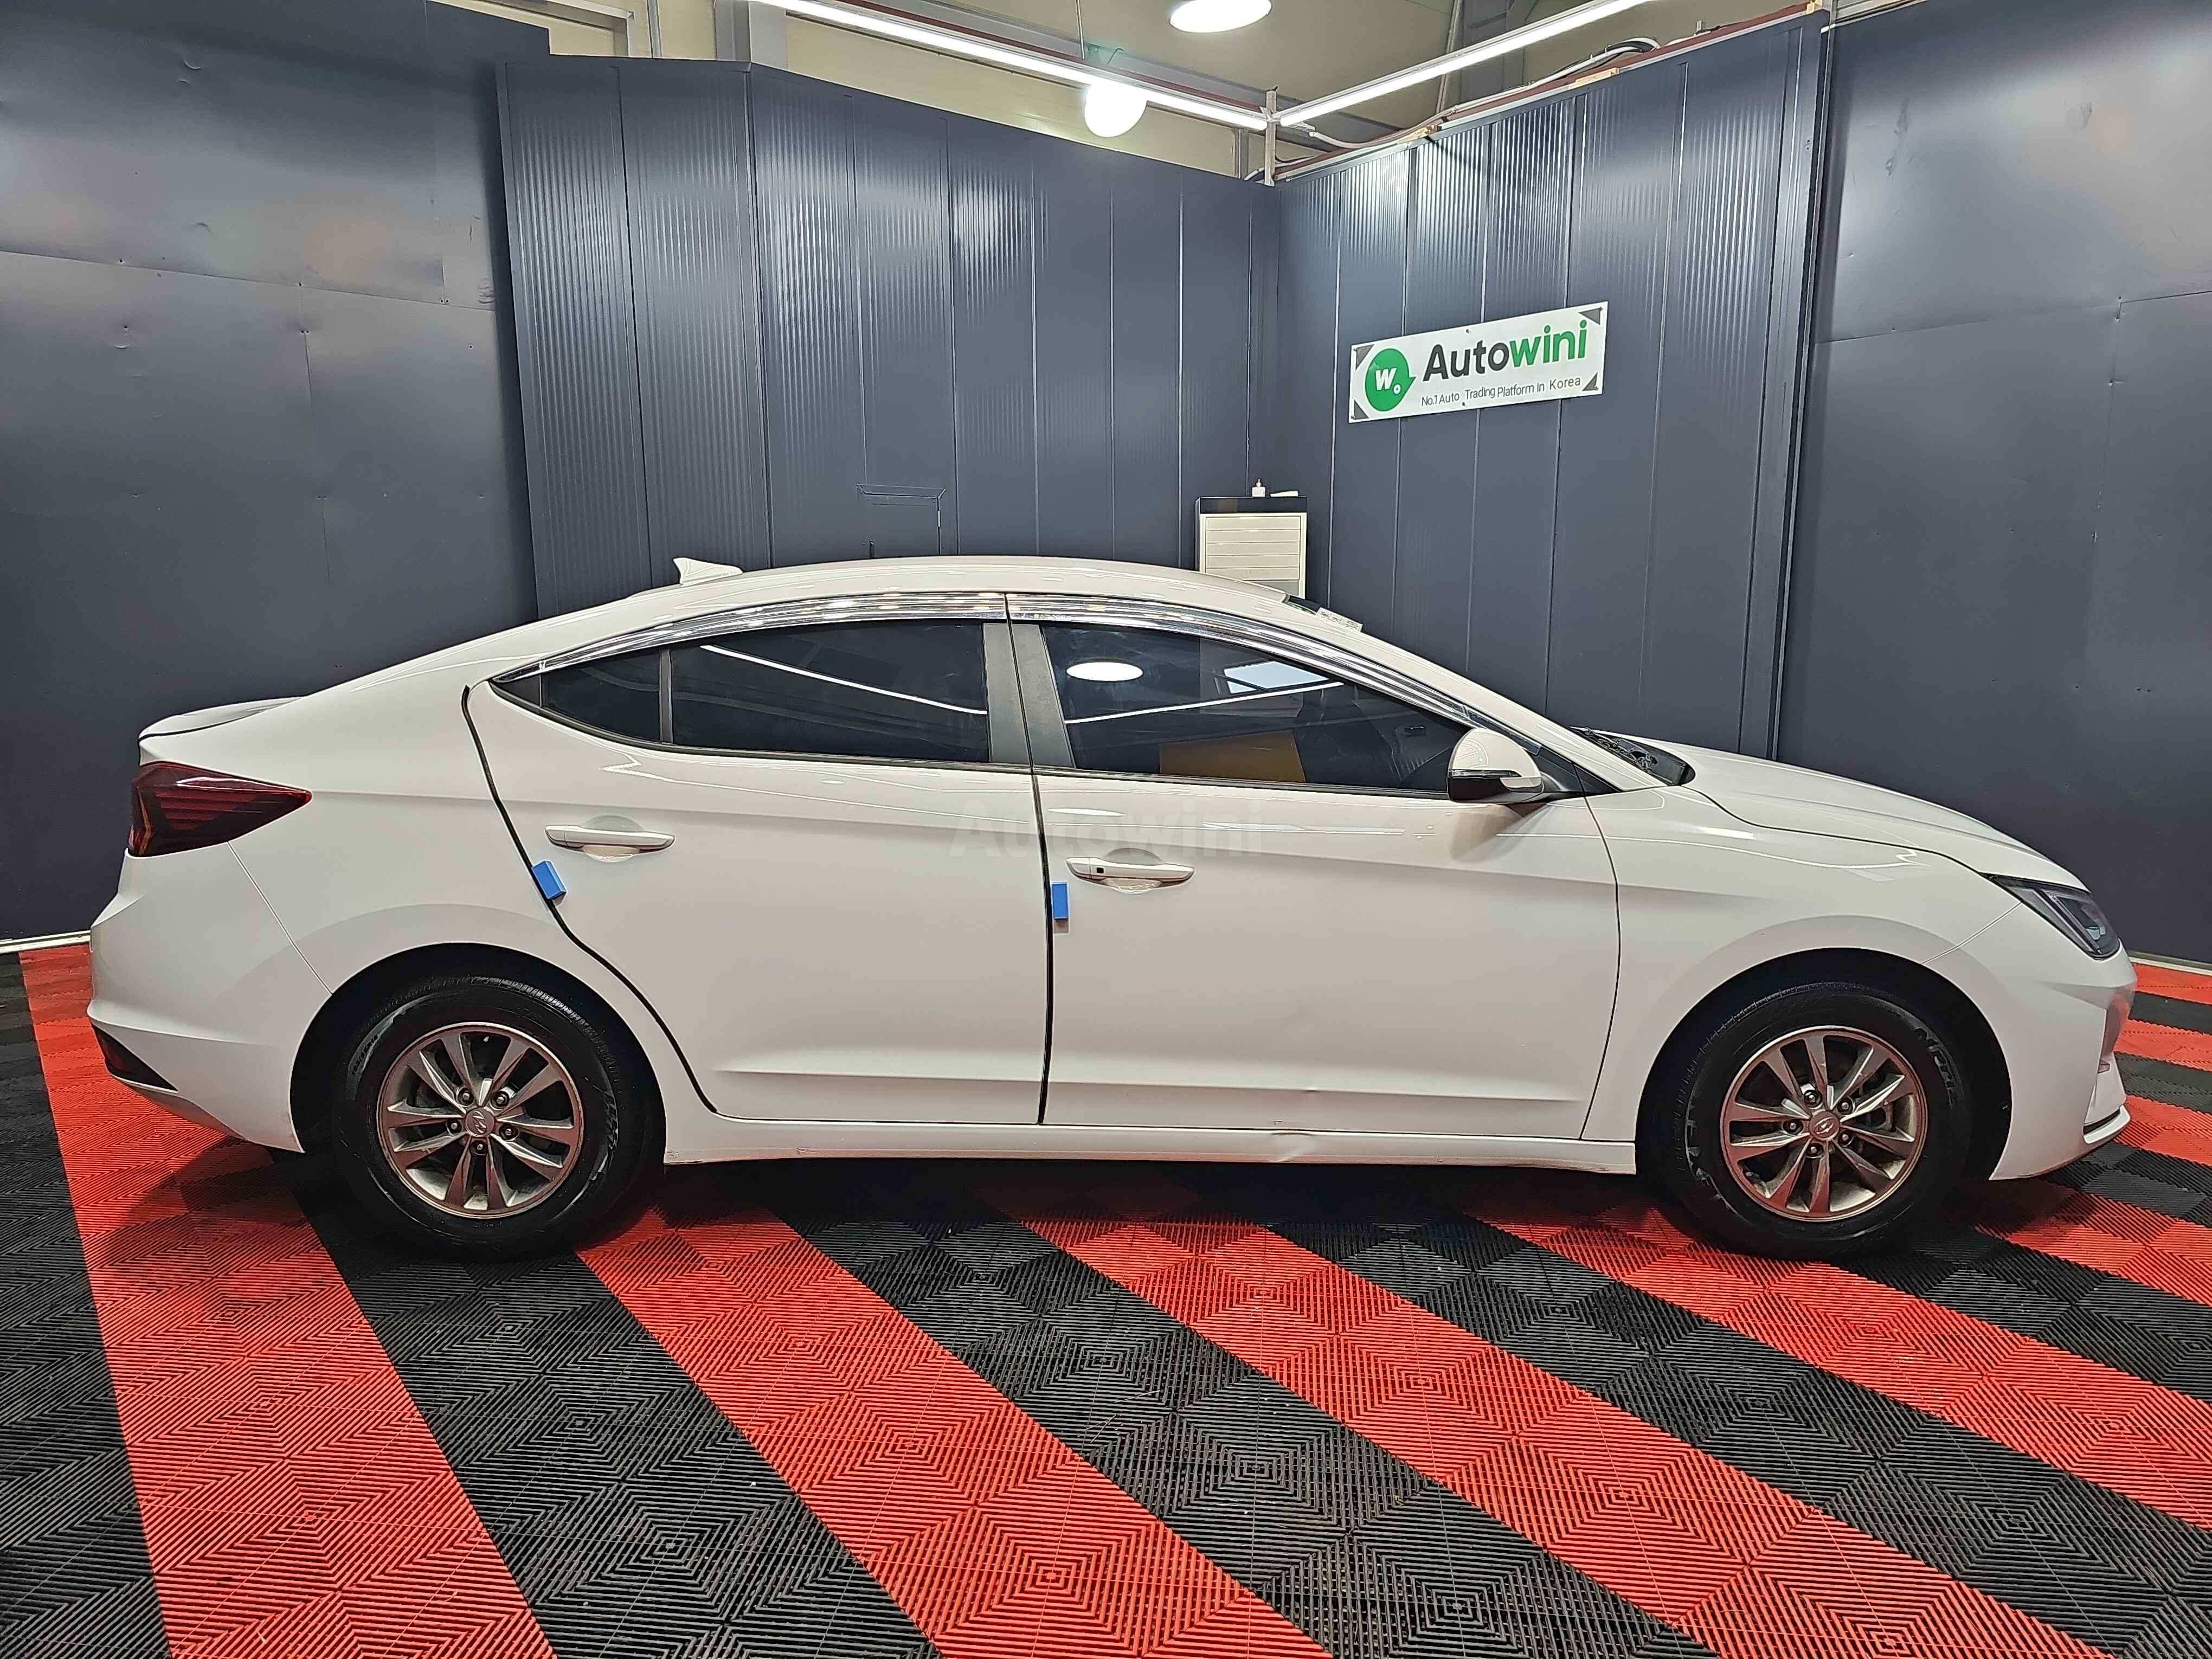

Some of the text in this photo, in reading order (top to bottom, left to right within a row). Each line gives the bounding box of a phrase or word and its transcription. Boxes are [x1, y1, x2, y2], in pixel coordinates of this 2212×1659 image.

[1422, 320, 1587, 382] Autowini
[1497, 383, 1535, 398] Platform
[1549, 377, 1581, 391] Korea
